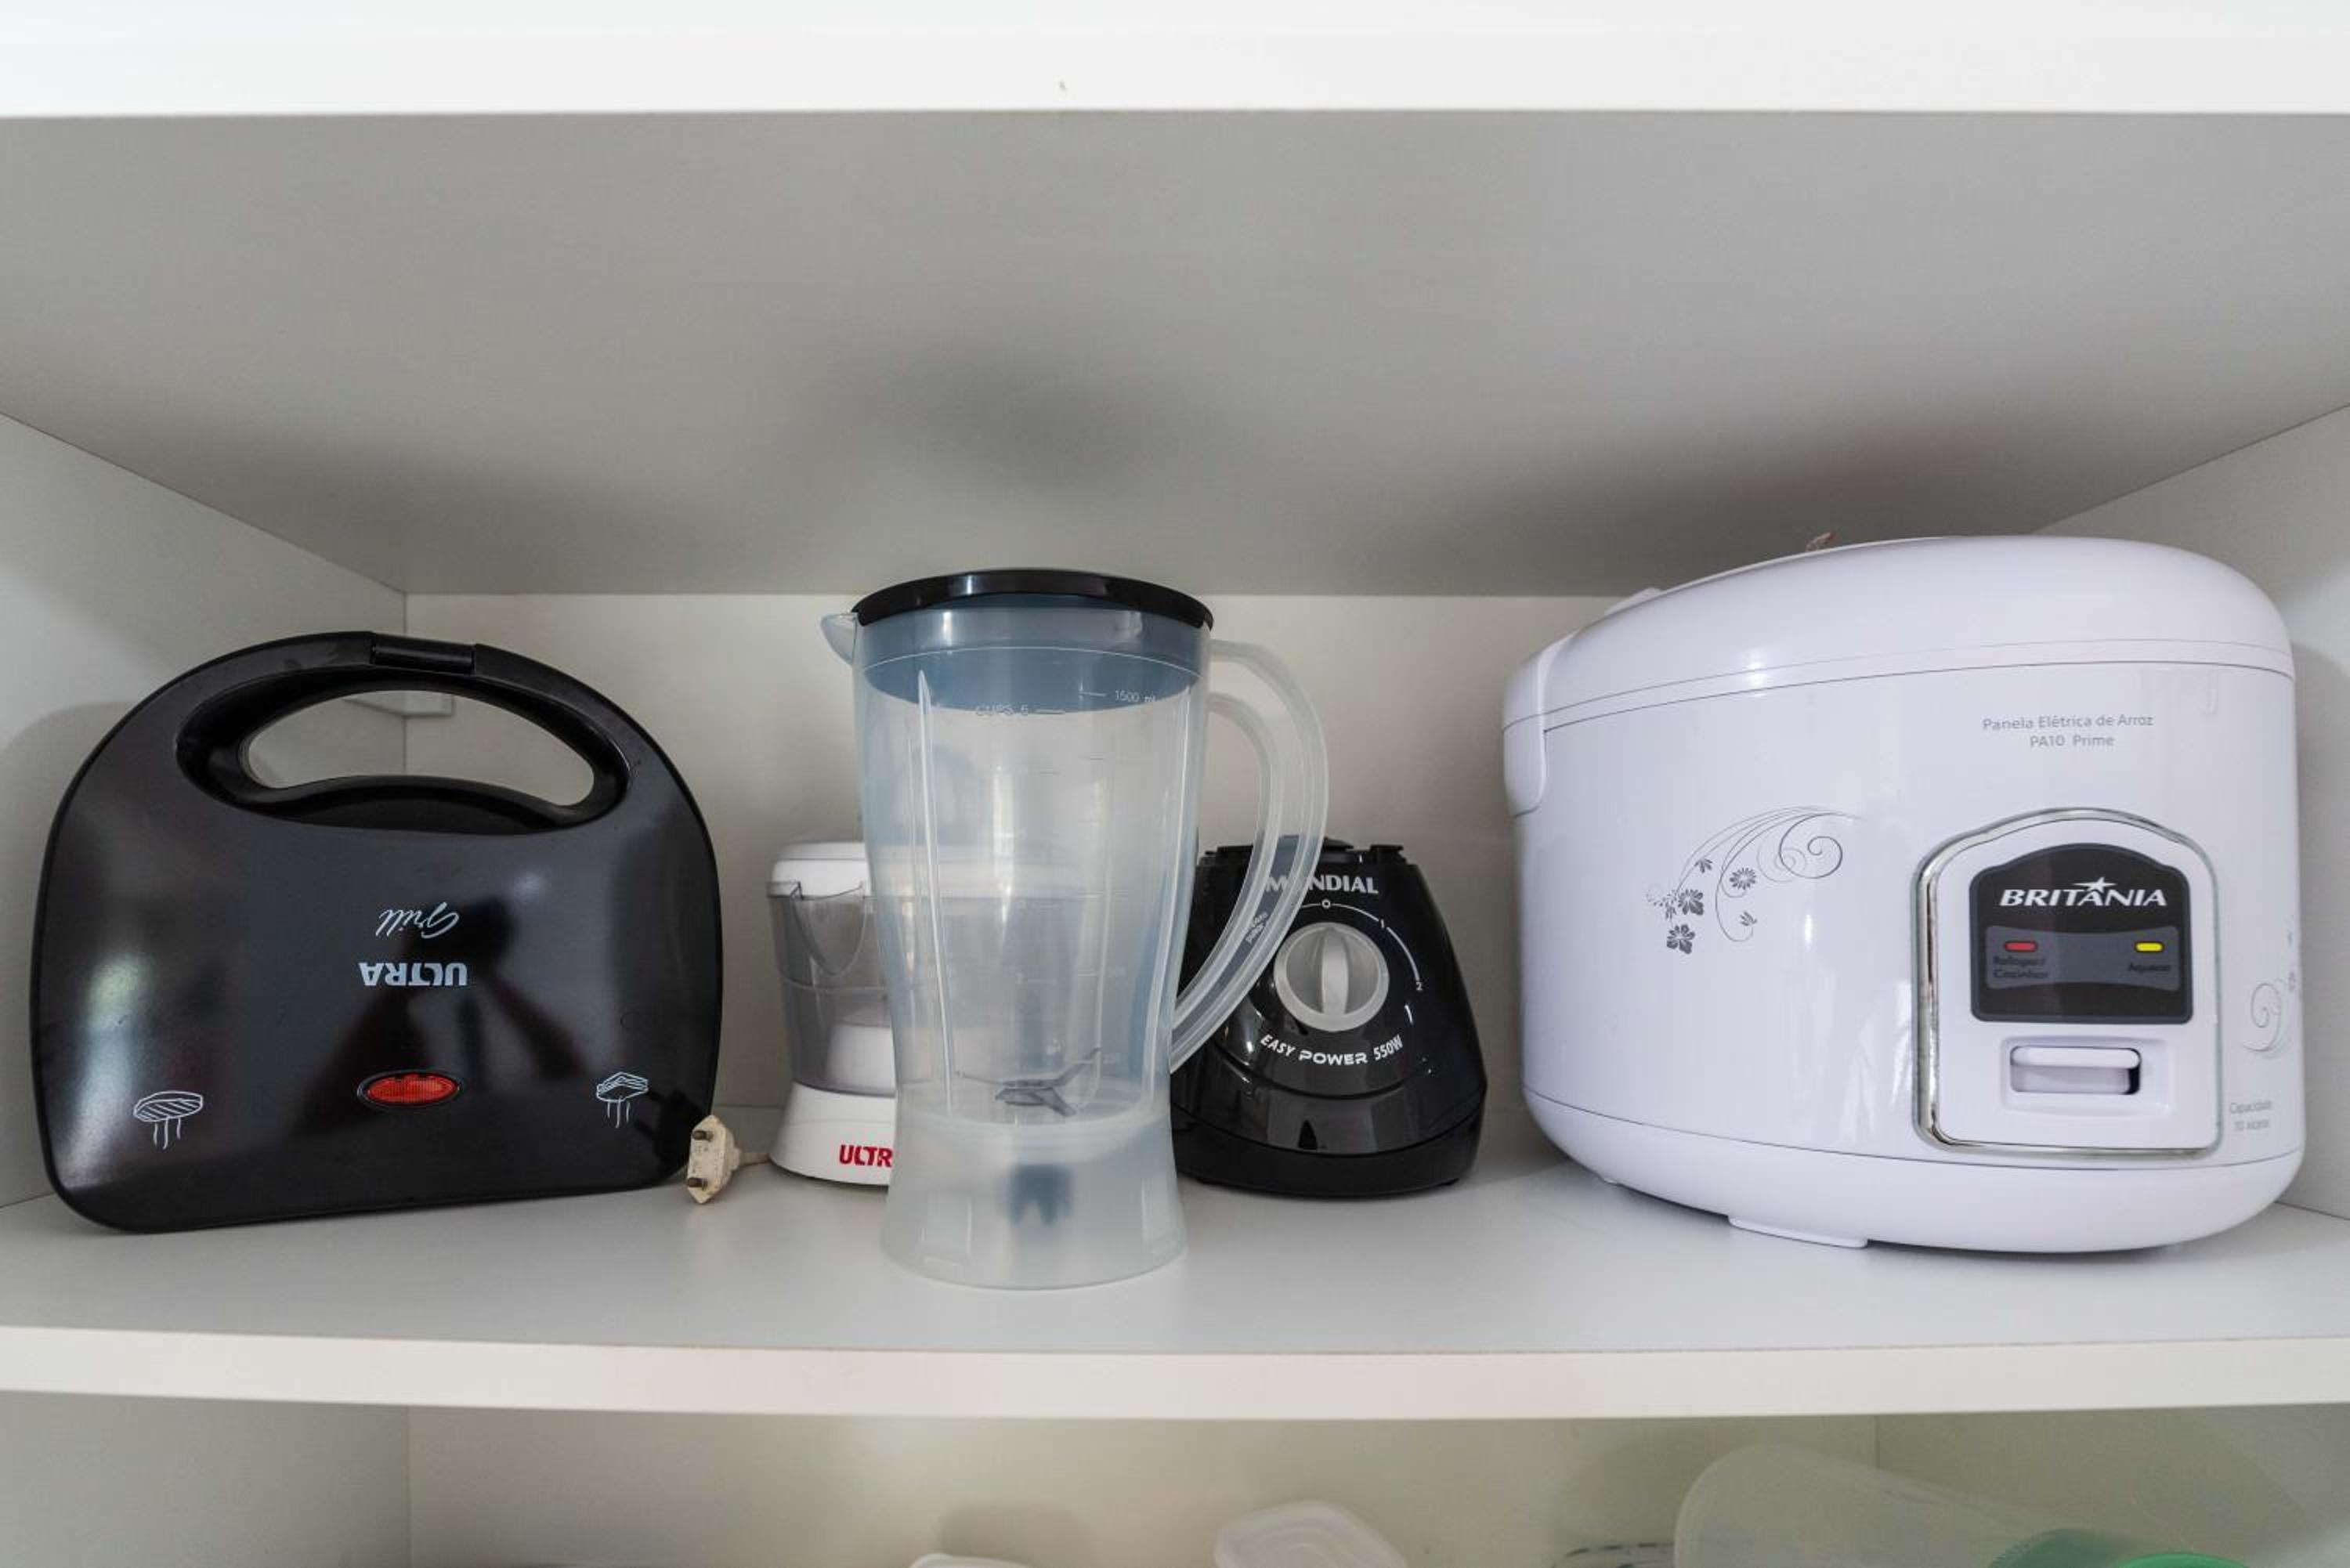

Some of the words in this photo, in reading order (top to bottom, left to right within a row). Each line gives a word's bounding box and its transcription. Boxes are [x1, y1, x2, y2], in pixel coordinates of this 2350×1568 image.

[1115, 690, 1140, 703] 1500
[1983, 717, 2034, 730] Panela
[2038, 714, 2092, 728] Elétrica
[2095, 714, 2113, 727] de
[2117, 714, 2153, 726] Arroz
[2030, 735, 2066, 747] PA10
[2073, 734, 2116, 746] Prime
[1264, 875, 1379, 894] MNDIAL
[375, 902, 461, 939] Grill
[357, 963, 468, 987] ULTRA
[1260, 1034, 1296, 1057] EASY
[1298, 1050, 1368, 1066] POWER
[1373, 1034, 1404, 1061] 550W
[839, 1143, 895, 1169] ULTR
